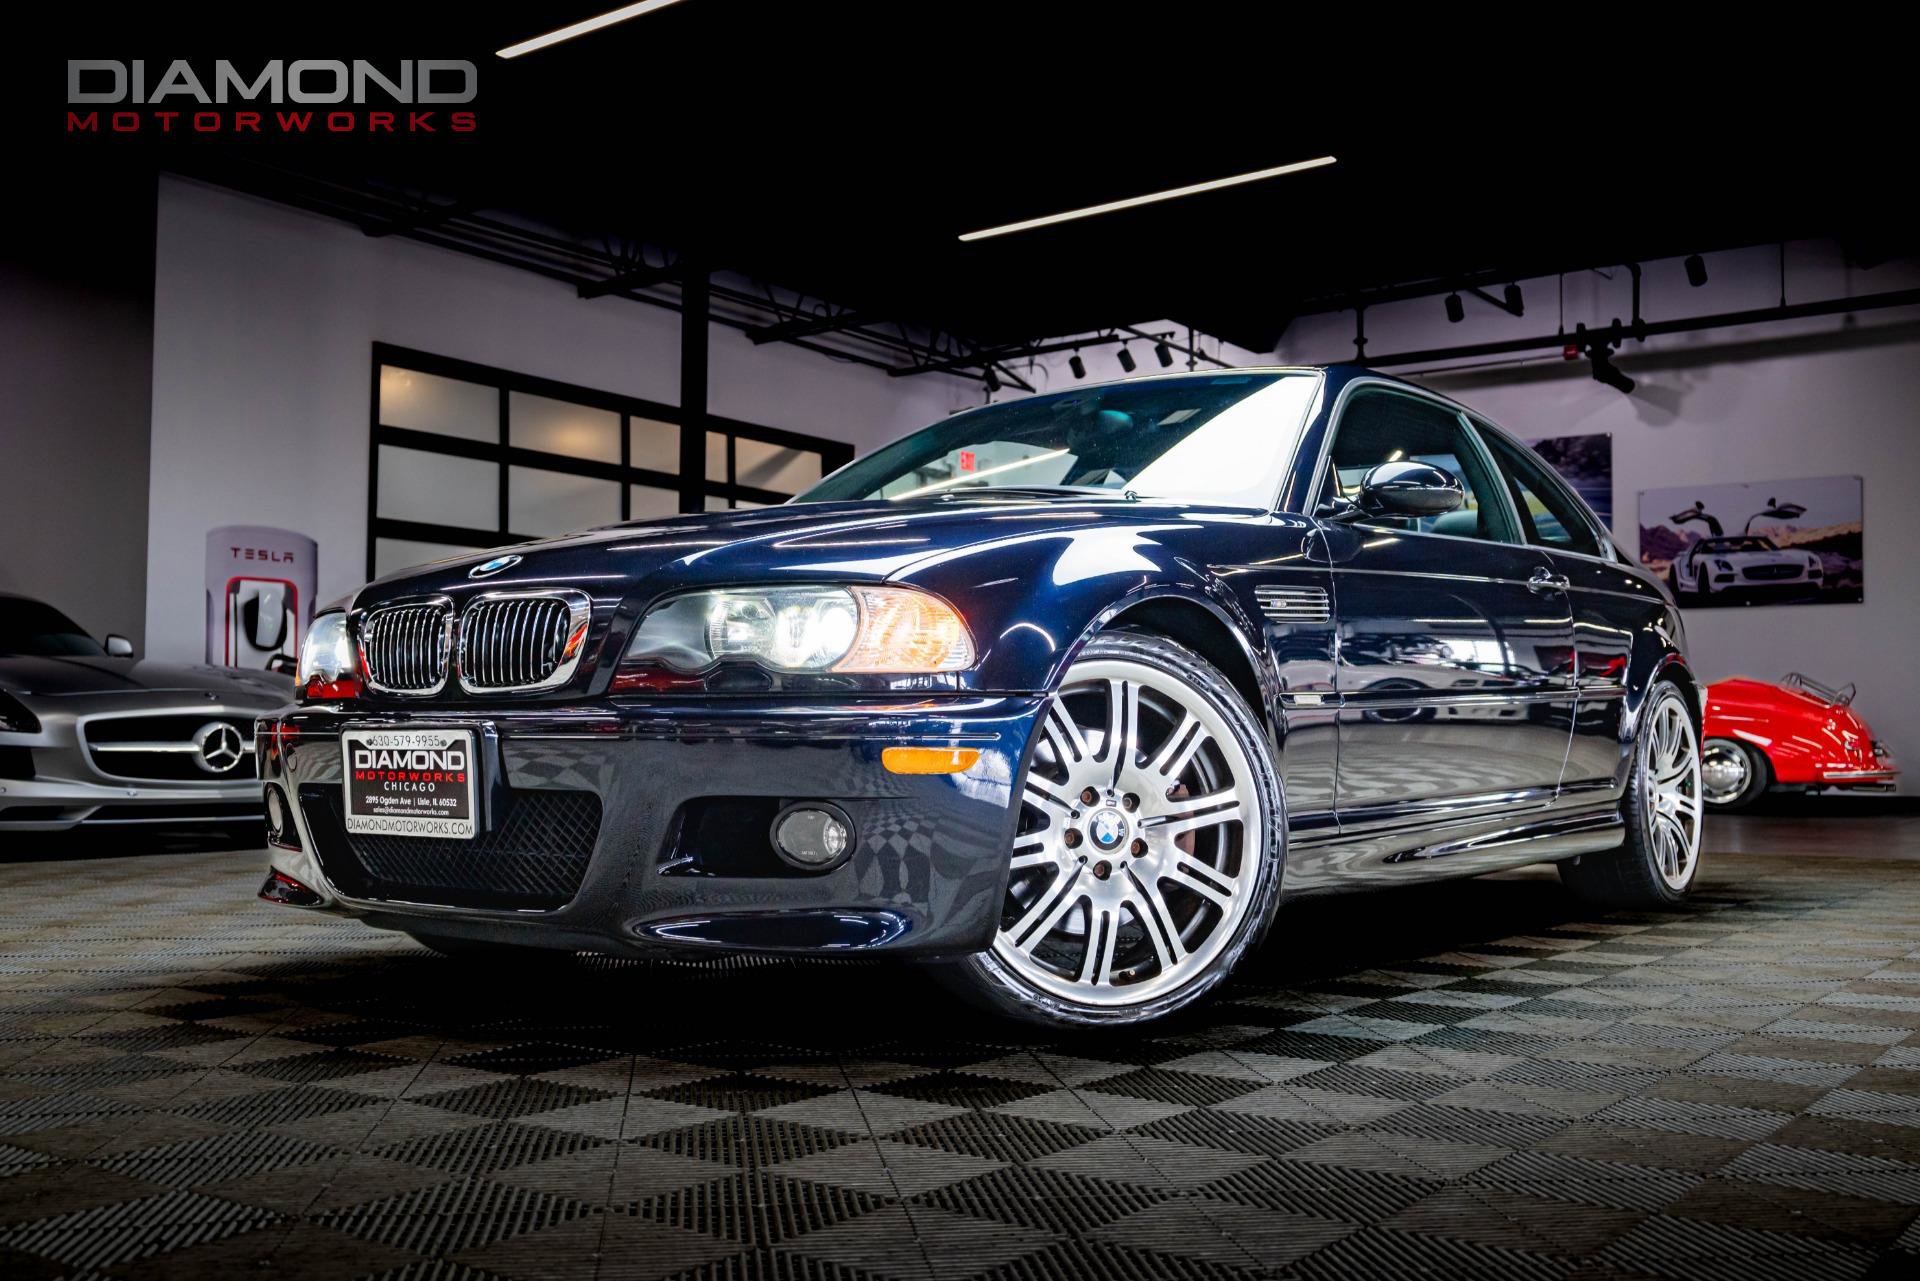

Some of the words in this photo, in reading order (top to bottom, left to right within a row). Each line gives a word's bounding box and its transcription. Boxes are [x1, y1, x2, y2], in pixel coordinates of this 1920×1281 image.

[230, 547, 294, 563] TESLA
[372, 735, 440, 747] 630-579-9955
[354, 750, 465, 770] DIAMOND
[355, 771, 465, 783] MOTORWORKS
[384, 782, 436, 792] CHICAGO
[379, 796, 398, 806] Ogden
[400, 797, 412, 805] Ave
[433, 798, 438, 806] IL
[347, 818, 473, 835] DIAMONDMOTORWORKS.COM
